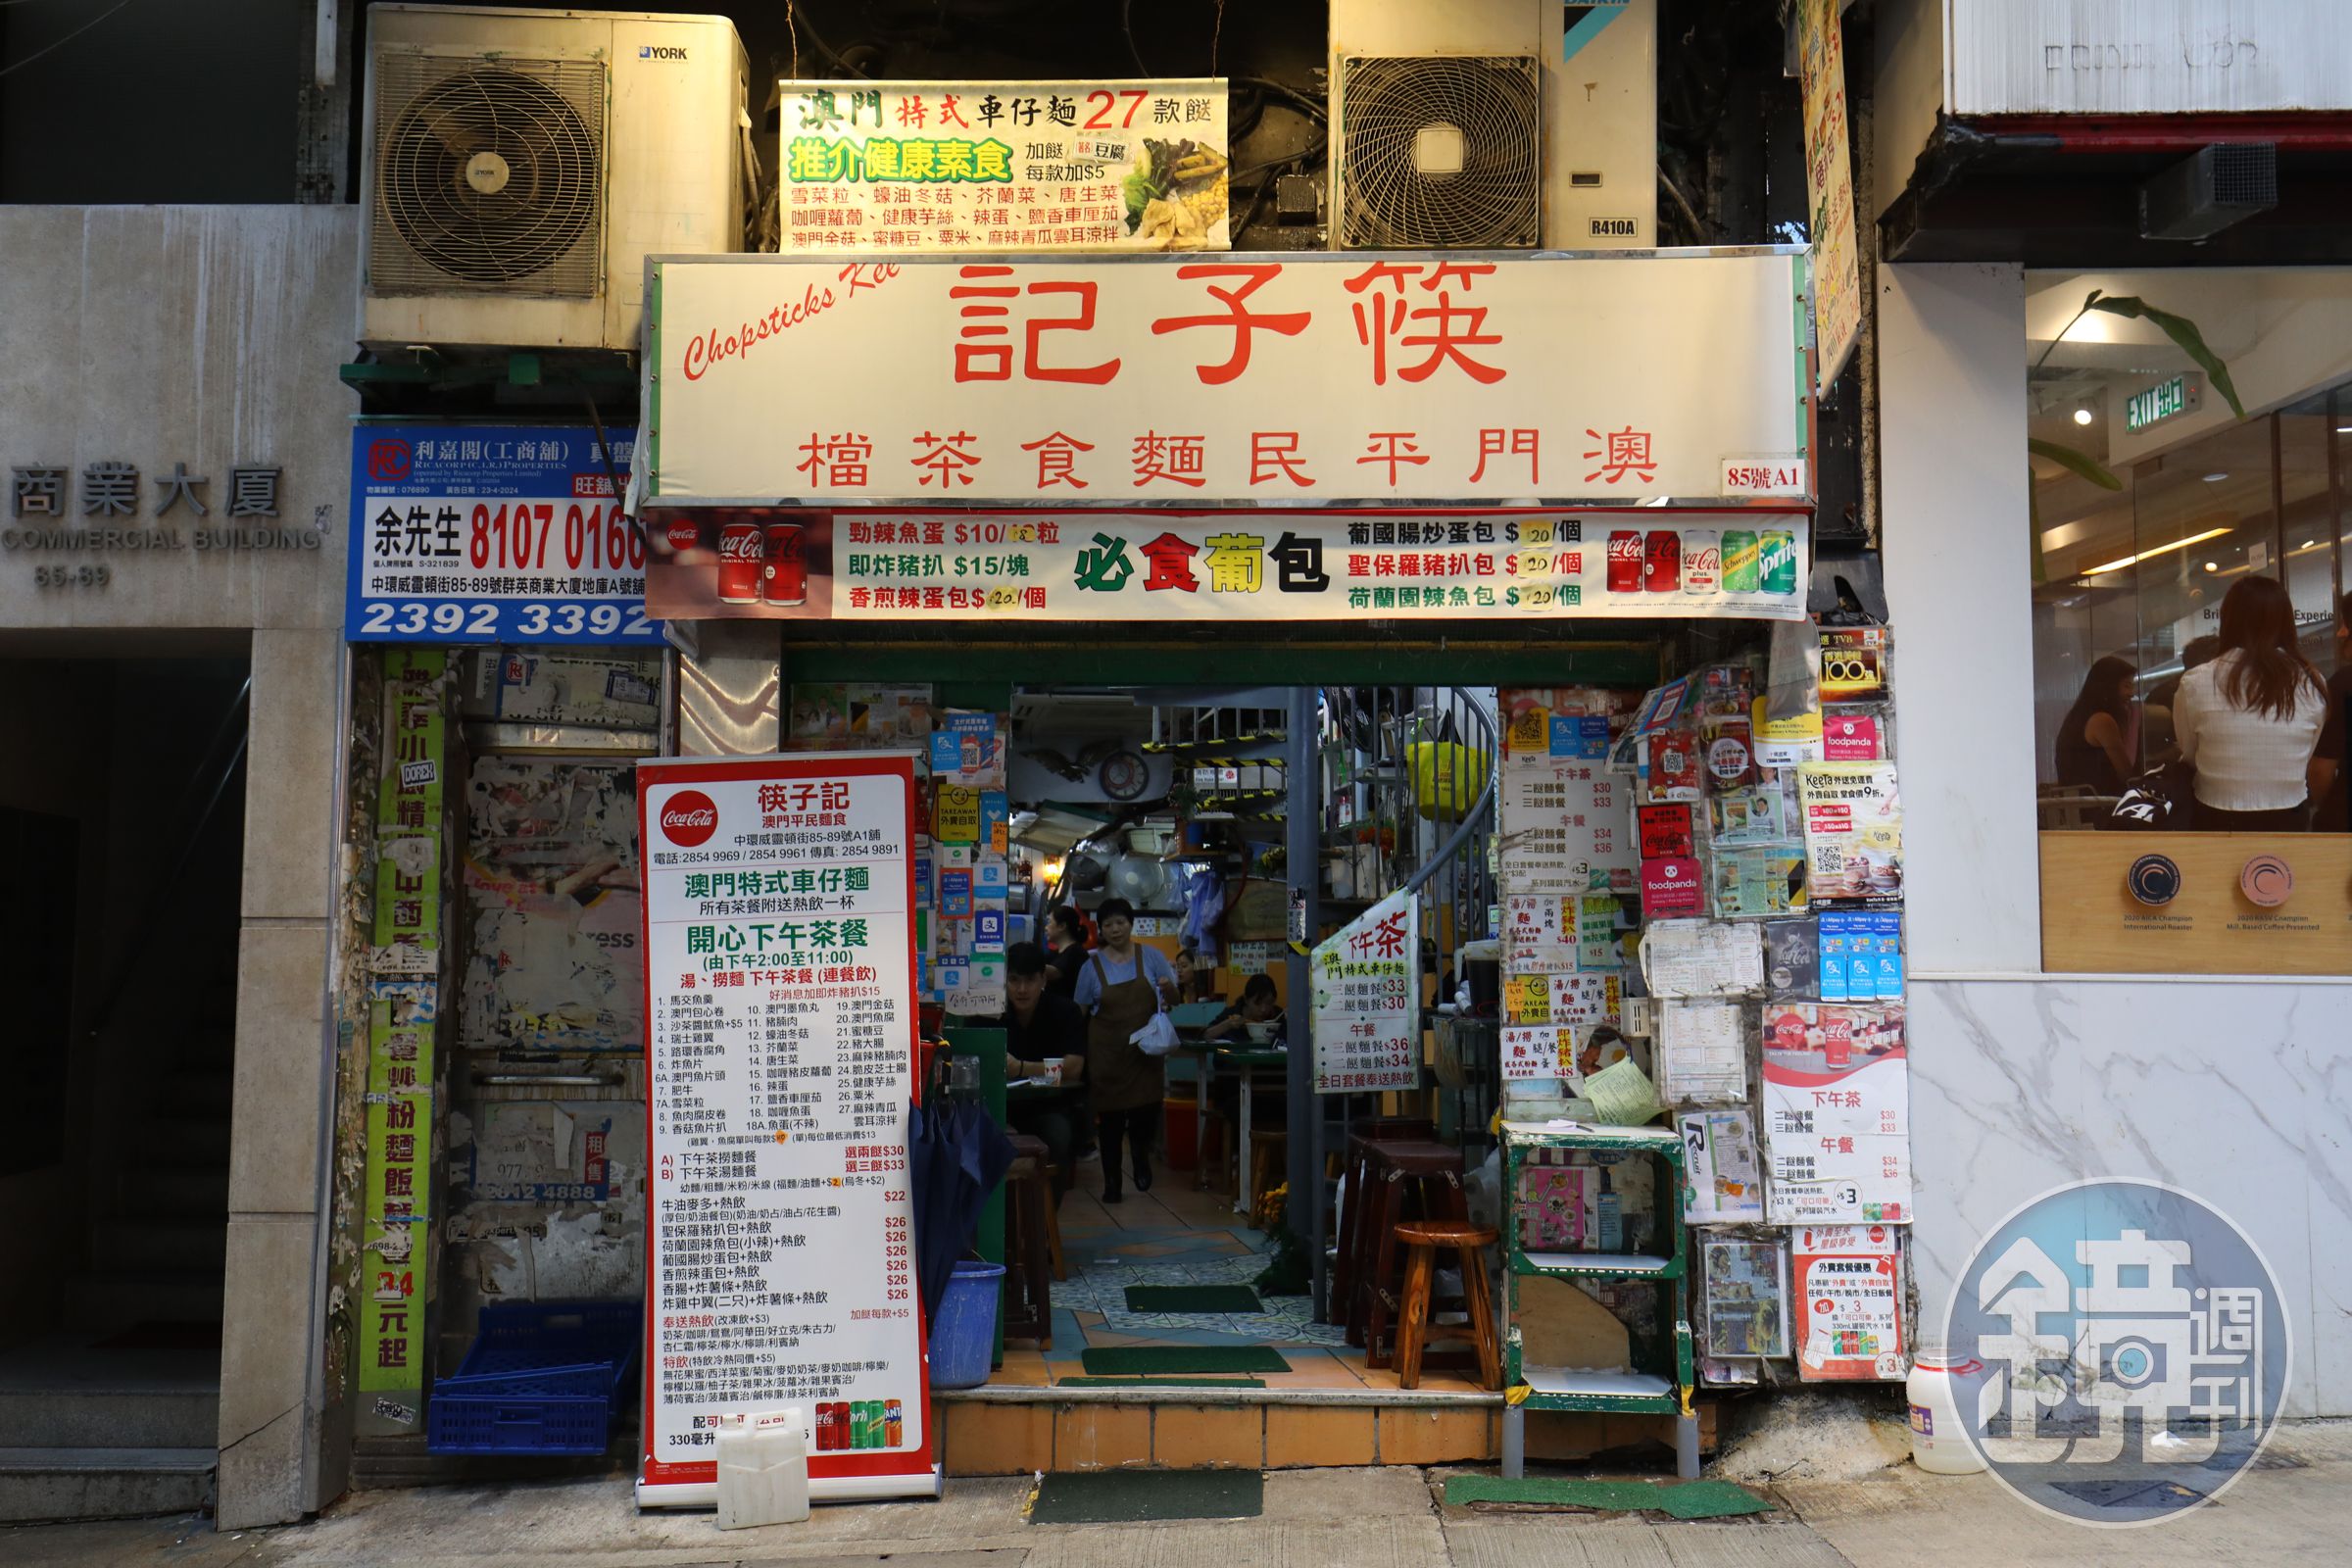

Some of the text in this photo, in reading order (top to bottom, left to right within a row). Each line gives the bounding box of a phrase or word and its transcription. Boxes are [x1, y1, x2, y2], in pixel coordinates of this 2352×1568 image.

[652, 47, 687, 61] YORK
[1026, 142, 1062, 160] 加餸
[791, 138, 1011, 180] 推介健康素食
[1026, 165, 1104, 181] 每款加$5
[1592, 220, 1635, 235] R410A
[684, 263, 900, 380] Chopsticks Kee
[416, 440, 569, 462] 利嘉閣(工商舖)
[1728, 465, 1800, 489] 85號A1
[10, 462, 284, 519] 商業大廈
[2, 528, 320, 551] COMMERCIAL BUILDING
[375, 506, 462, 557] 余先生
[470, 504, 553, 569] 8107
[849, 521, 945, 545] 勁辣魚蛋
[1348, 521, 1495, 545] 葡國腸炒蛋包
[849, 554, 1029, 577] 即炸豬扒 $15/塊
[1075, 531, 1330, 594] 必食葡包
[1348, 553, 1495, 576] 聖保羅豬扒包
[1348, 586, 1496, 609] 荷蘭園辣魚包
[361, 604, 653, 634] 2392 3392
[1828, 737, 1871, 748] foodpanda
[1553, 768, 1592, 780] 下午茶
[1593, 784, 1611, 793] $30
[759, 782, 850, 813] 筷子記
[1593, 798, 1611, 808] $33
[663, 809, 713, 827] Coca-Cola
[762, 813, 846, 828] 澳門平民麵食
[941, 816, 977, 825] 外賣自取
[1593, 829, 1611, 838] $34
[712, 851, 740, 861] 9969
[749, 850, 776, 860] 2854
[780, 849, 806, 858] 9961
[842, 846, 868, 857] 2854
[872, 845, 899, 855] 9891
[1593, 844, 1611, 853] $36
[685, 866, 869, 899] 澳門特式車仔麵
[1648, 879, 1696, 890] foodpanda
[700, 896, 855, 915] 所有茶餐附送熱飲一杯
[688, 919, 868, 955] 開心下午茶餐
[704, 951, 853, 972] (由下午2:00至11:00)
[680, 967, 876, 989] 湯、撈麵 下午茶餐 (連餐飲)
[770, 986, 880, 1002] 好消息加即炸豬扒$15
[671, 1007, 724, 1019] 澳門包心卷
[766, 1002, 819, 1014] 澳門墨魚丸
[766, 1016, 798, 1027] 豬腩肉
[1350, 1024, 1376, 1037] 午餐
[671, 1033, 713, 1044] 瑞士雞翼
[766, 1042, 798, 1053] 芥蘭菜
[671, 1059, 704, 1070] 炸魚片
[766, 1054, 799, 1066] 唐生菜
[672, 1070, 725, 1084] 澳門魚片頭
[672, 1086, 693, 1096] 肥牛
[767, 1080, 788, 1092] 辣蛋
[672, 1098, 704, 1109] 雪菜粒
[1811, 1091, 1861, 1107] 下午茶
[672, 1109, 726, 1121] 魚肉腐皮卷
[672, 1122, 726, 1135] 香菇魚片扒
[1882, 1123, 1895, 1132] $33
[1821, 1137, 1854, 1152] 午餐
[680, 1151, 757, 1166] 下午茶撈麵餐
[845, 1145, 904, 1158] 選兩餸$30
[1883, 1156, 1897, 1165] $34
[680, 1164, 757, 1180] 下午茶湯麵餐
[845, 1159, 905, 1173] 選三餸$33
[1884, 1169, 1897, 1178] $36
[884, 1191, 906, 1201] $22
[886, 1217, 906, 1227] $26
[886, 1231, 906, 1242] $26
[886, 1246, 907, 1256] $26
[887, 1260, 907, 1271] $26
[887, 1275, 907, 1286] $26
[888, 1290, 908, 1299] $26
